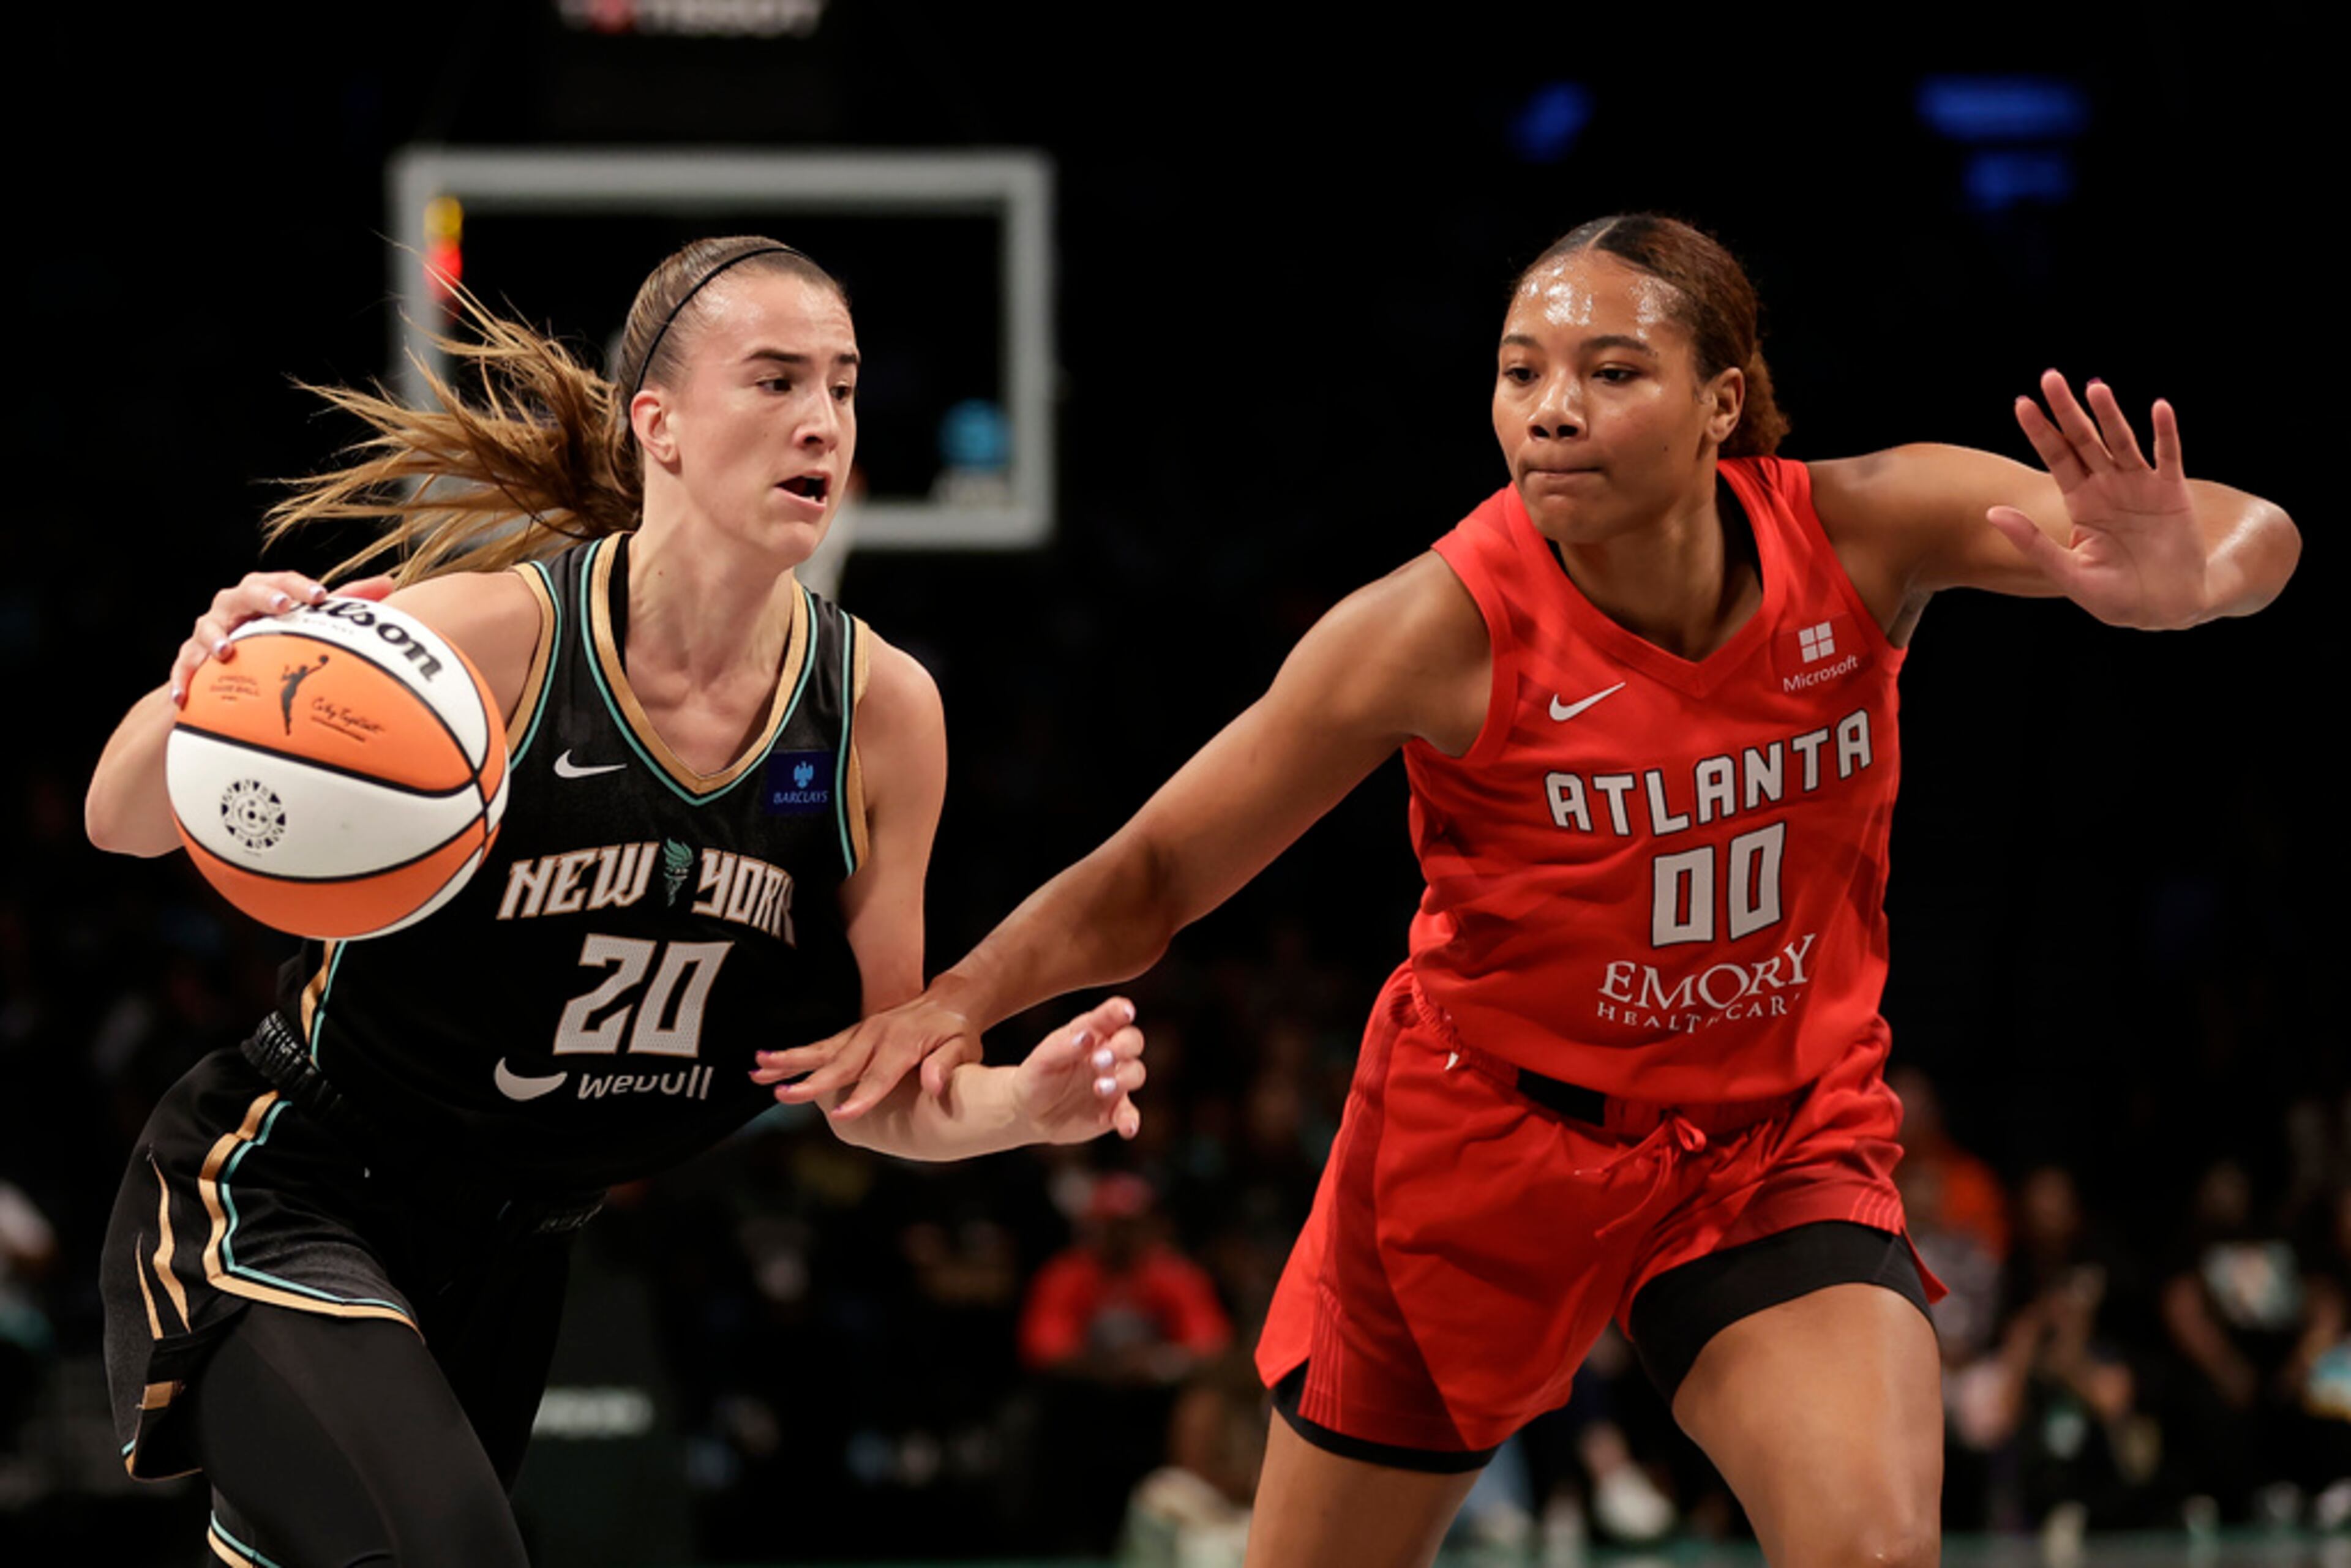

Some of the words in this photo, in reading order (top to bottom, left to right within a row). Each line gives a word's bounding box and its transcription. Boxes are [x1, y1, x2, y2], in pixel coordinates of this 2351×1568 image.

[1783, 655, 1858, 693] Microsoft
[1545, 709, 1872, 836] ATLANTA
[495, 841, 660, 920] NEW
[691, 847, 797, 949] YORK
[1651, 821, 1785, 950] 00
[553, 933, 735, 1058] 20
[1597, 934, 1816, 1010] EMORY
[1597, 992, 1801, 1033] HEALTCAR
